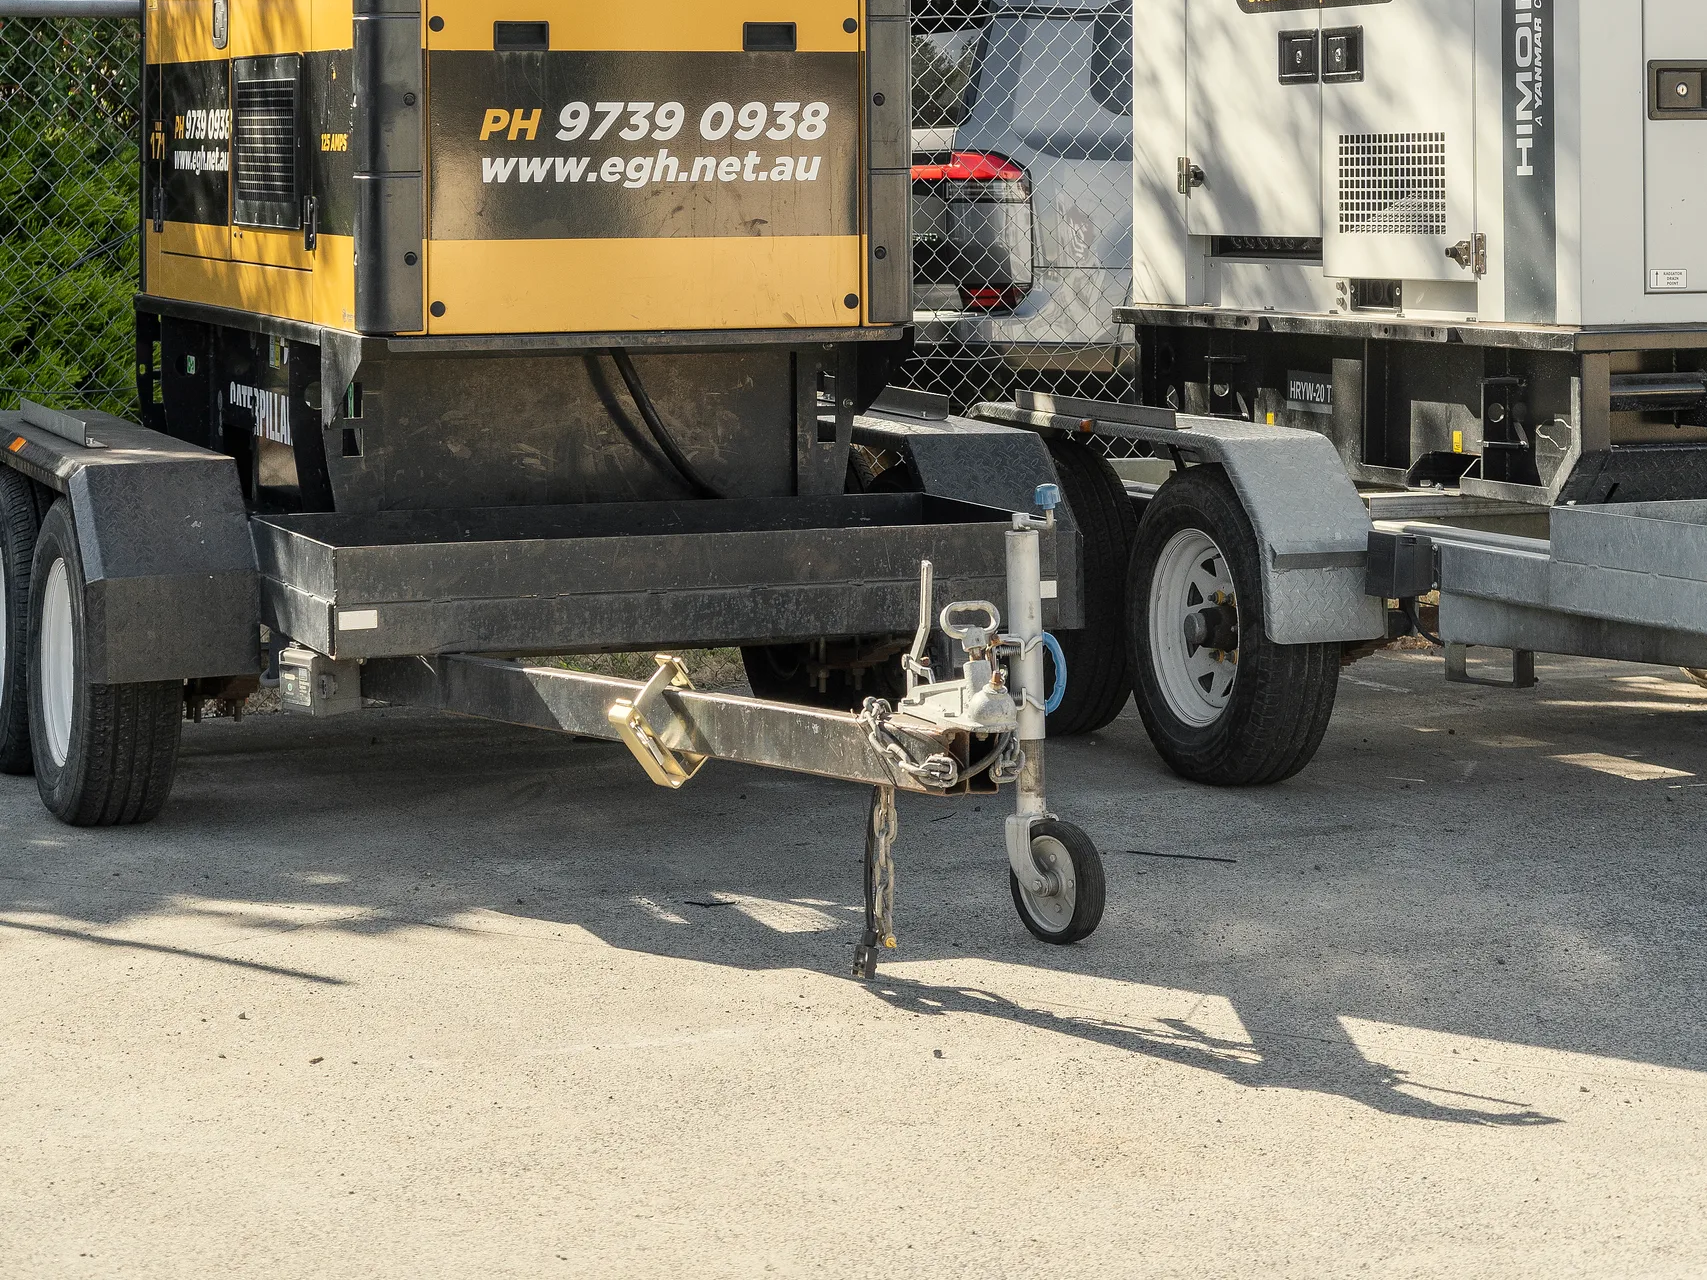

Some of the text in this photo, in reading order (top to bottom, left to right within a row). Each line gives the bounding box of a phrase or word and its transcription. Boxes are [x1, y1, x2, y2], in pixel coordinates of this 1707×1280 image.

[1534, 17, 1543, 112] YANMAR
[174, 109, 233, 140] PH 9739 0938
[479, 101, 830, 142] PH 9739 0938
[1534, 115, 1543, 127] A
[150, 132, 166, 159] 171
[330, 133, 349, 152] AMPS
[482, 149, 822, 189] www.egh.net.au
[1290, 380, 1325, 403] HRYW-20
